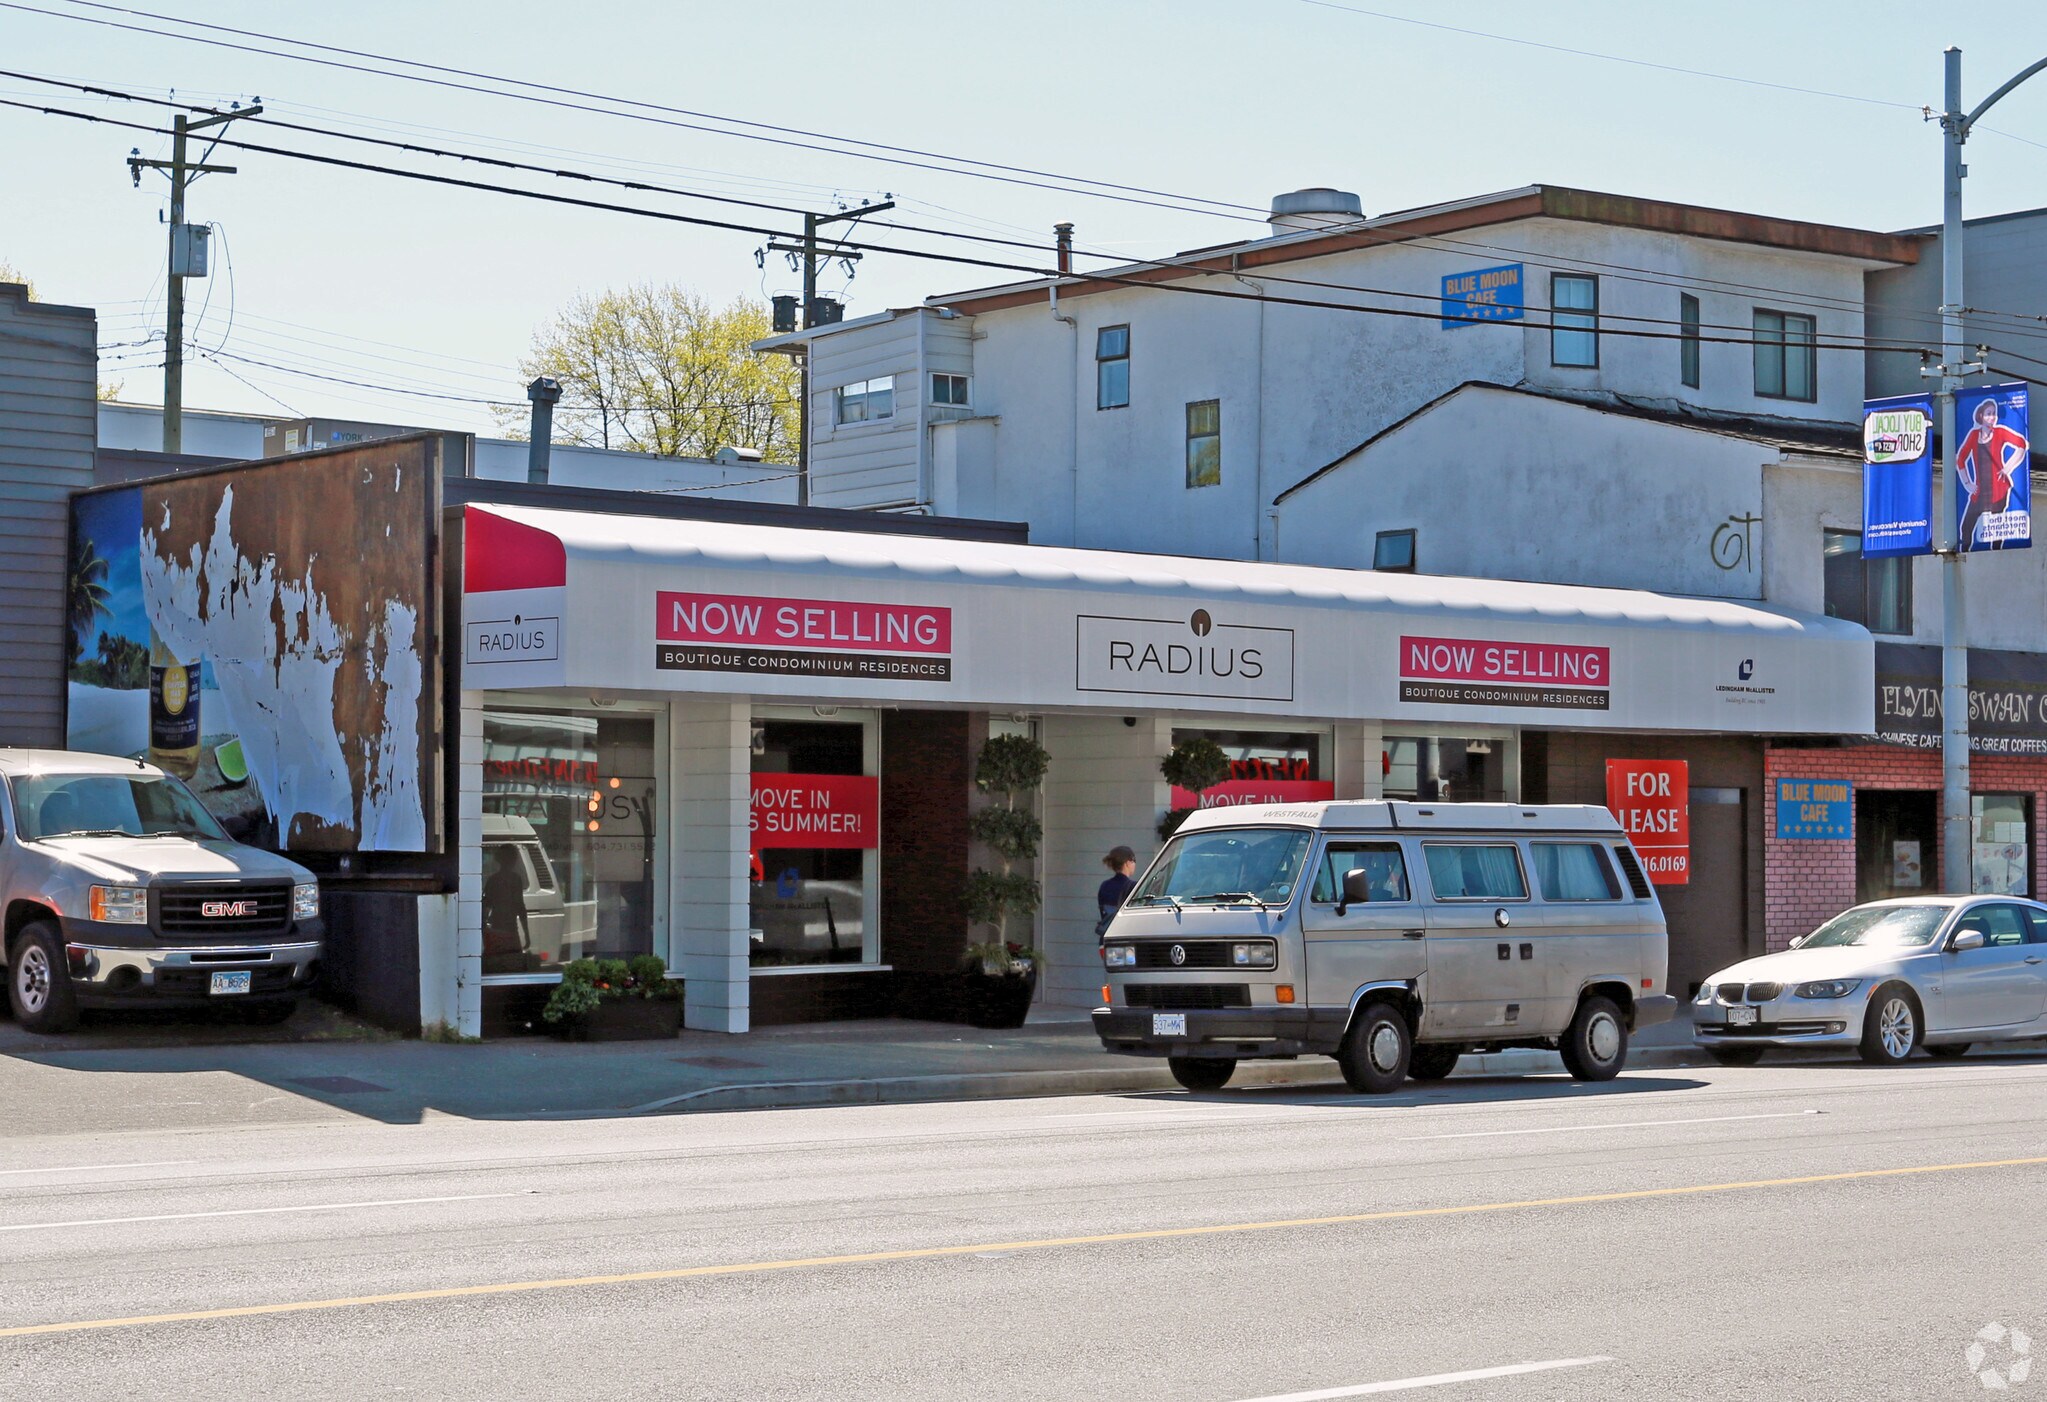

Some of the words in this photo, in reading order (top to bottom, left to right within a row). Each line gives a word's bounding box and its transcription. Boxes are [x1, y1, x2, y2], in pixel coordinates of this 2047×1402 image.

[1446, 276, 1476, 295] BLUE
[1480, 269, 1518, 289] MOON
[1466, 289, 1497, 309] CAFE
[340, 431, 363, 441] YORK
[673, 601, 762, 636] NOW
[775, 606, 938, 645] SELLING
[479, 631, 545, 652] RADIUS
[665, 652, 742, 667] BOUTIQUE
[748, 656, 853, 671] CONDOMINIUM
[859, 661, 946, 675] RESIDENCES
[1110, 641, 1263, 679] RADIUS
[1411, 644, 1475, 673] NOW
[1483, 648, 1600, 680] SELLING
[1405, 687, 1460, 699] BOUTIQUE
[1464, 690, 1539, 702] CONDOMINIUM
[1543, 694, 1605, 705] RESIDENCES
[1881, 686, 1944, 718] FLYIN
[1968, 690, 2033, 723] SWAN
[1920, 734, 1942, 748] CAFE
[1981, 737, 2009, 752] GREAT
[2011, 738, 2047, 753] COFFEES
[1627, 772, 1671, 797] FOR
[1782, 783, 1810, 801] BLUE
[1813, 784, 1847, 802] MOON
[503, 795, 631, 820] RAIUS
[750, 788, 803, 808] MOVE
[810, 790, 830, 809] IN
[765, 812, 862, 833] SUMMER!
[1263, 810, 1319, 819] WESTFALIA
[1618, 808, 1678, 833] LEASE
[1800, 803, 1829, 822] CAFE
[202, 901, 257, 916] GMC
